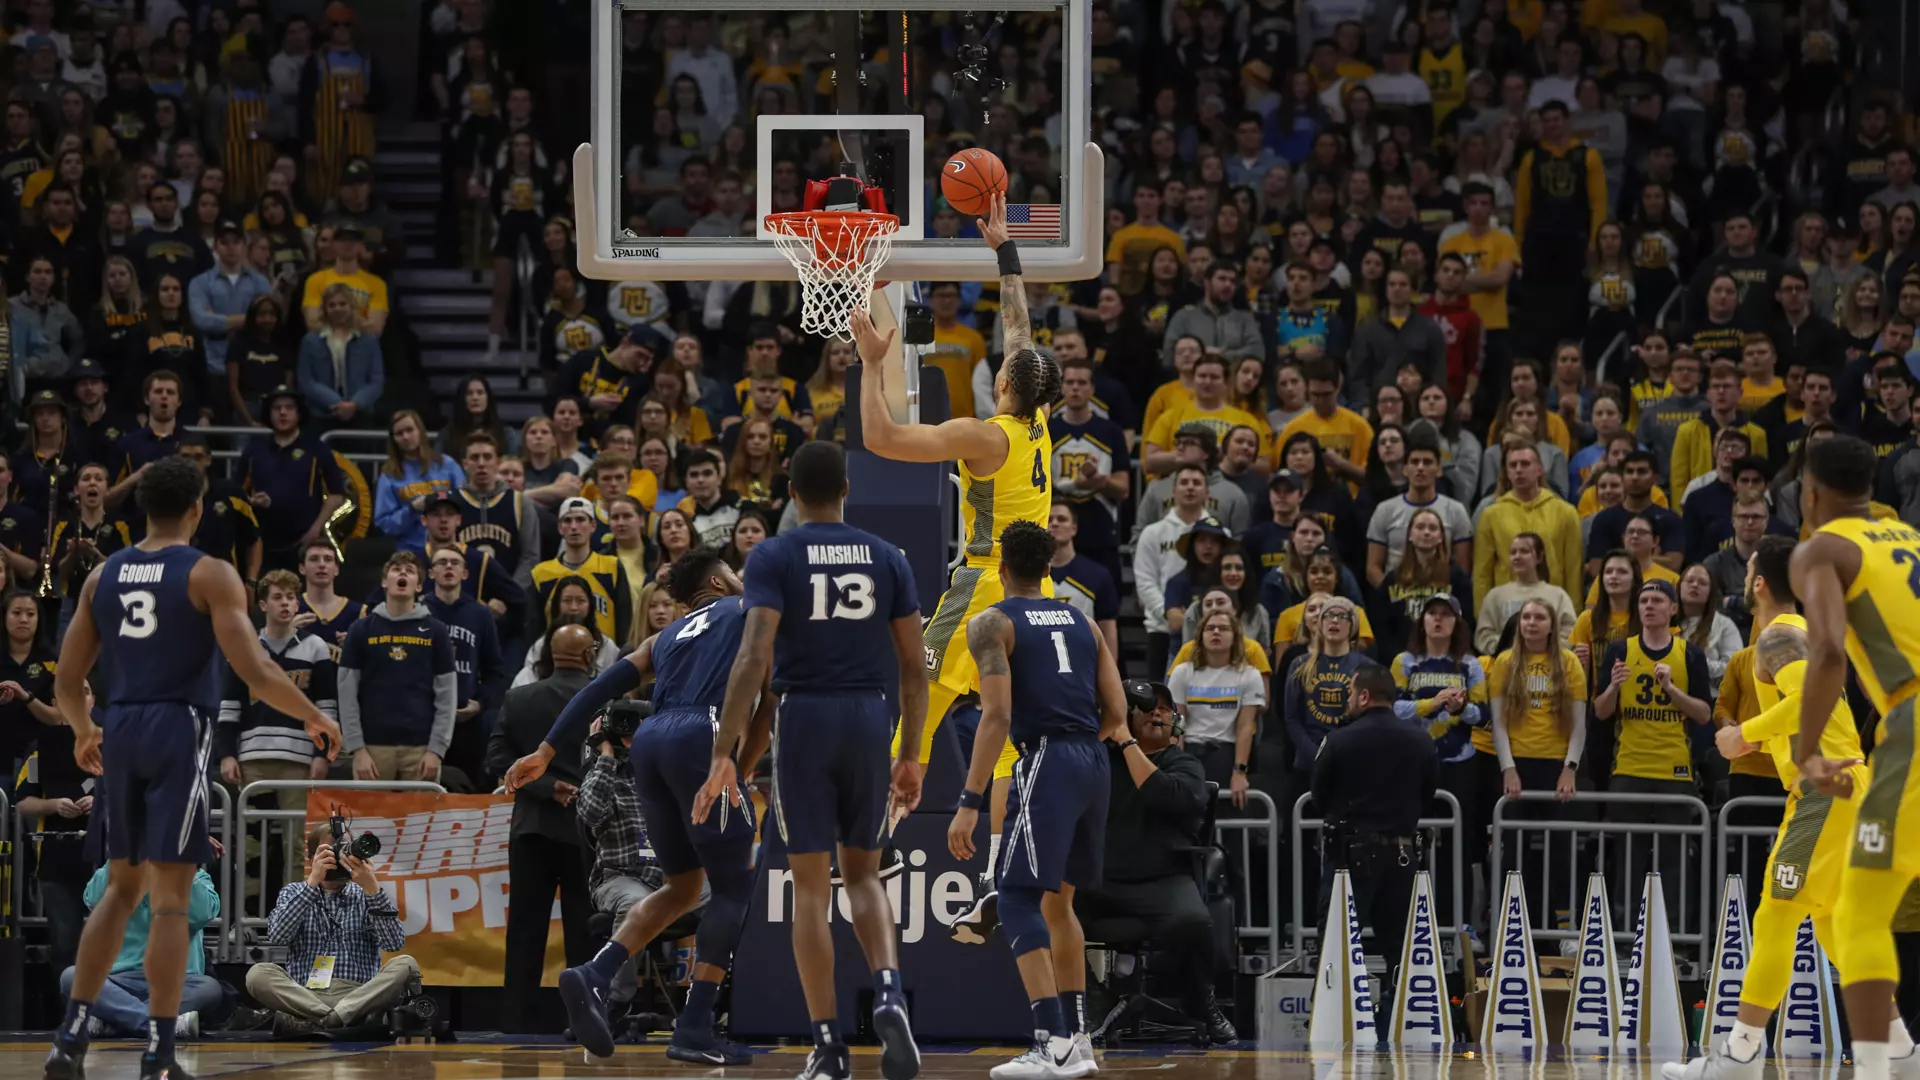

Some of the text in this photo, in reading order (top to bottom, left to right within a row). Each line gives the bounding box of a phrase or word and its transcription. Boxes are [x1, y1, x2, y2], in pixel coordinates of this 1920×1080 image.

[612, 248, 659, 258] SPALDING
[1031, 448, 1048, 494] 4
[118, 563, 165, 584] GOODIN
[806, 544, 874, 565] MARSHALL
[118, 590, 159, 640] 3
[809, 572, 876, 621] 13
[1024, 609, 1076, 626] SCRUGGS
[675, 610, 711, 641] 4
[1050, 631, 1074, 674] 1
[1623, 707, 1683, 723] MARQUETTE
[1857, 822, 1886, 854] MU
[1775, 863, 1800, 890] MU
[1721, 898, 1744, 971] RING
[1404, 894, 1442, 1036] RING OUT
[1495, 895, 1533, 1039] RING OUT
[1573, 895, 1610, 1037] RING OUT
[1784, 982, 1822, 1045] OUT
